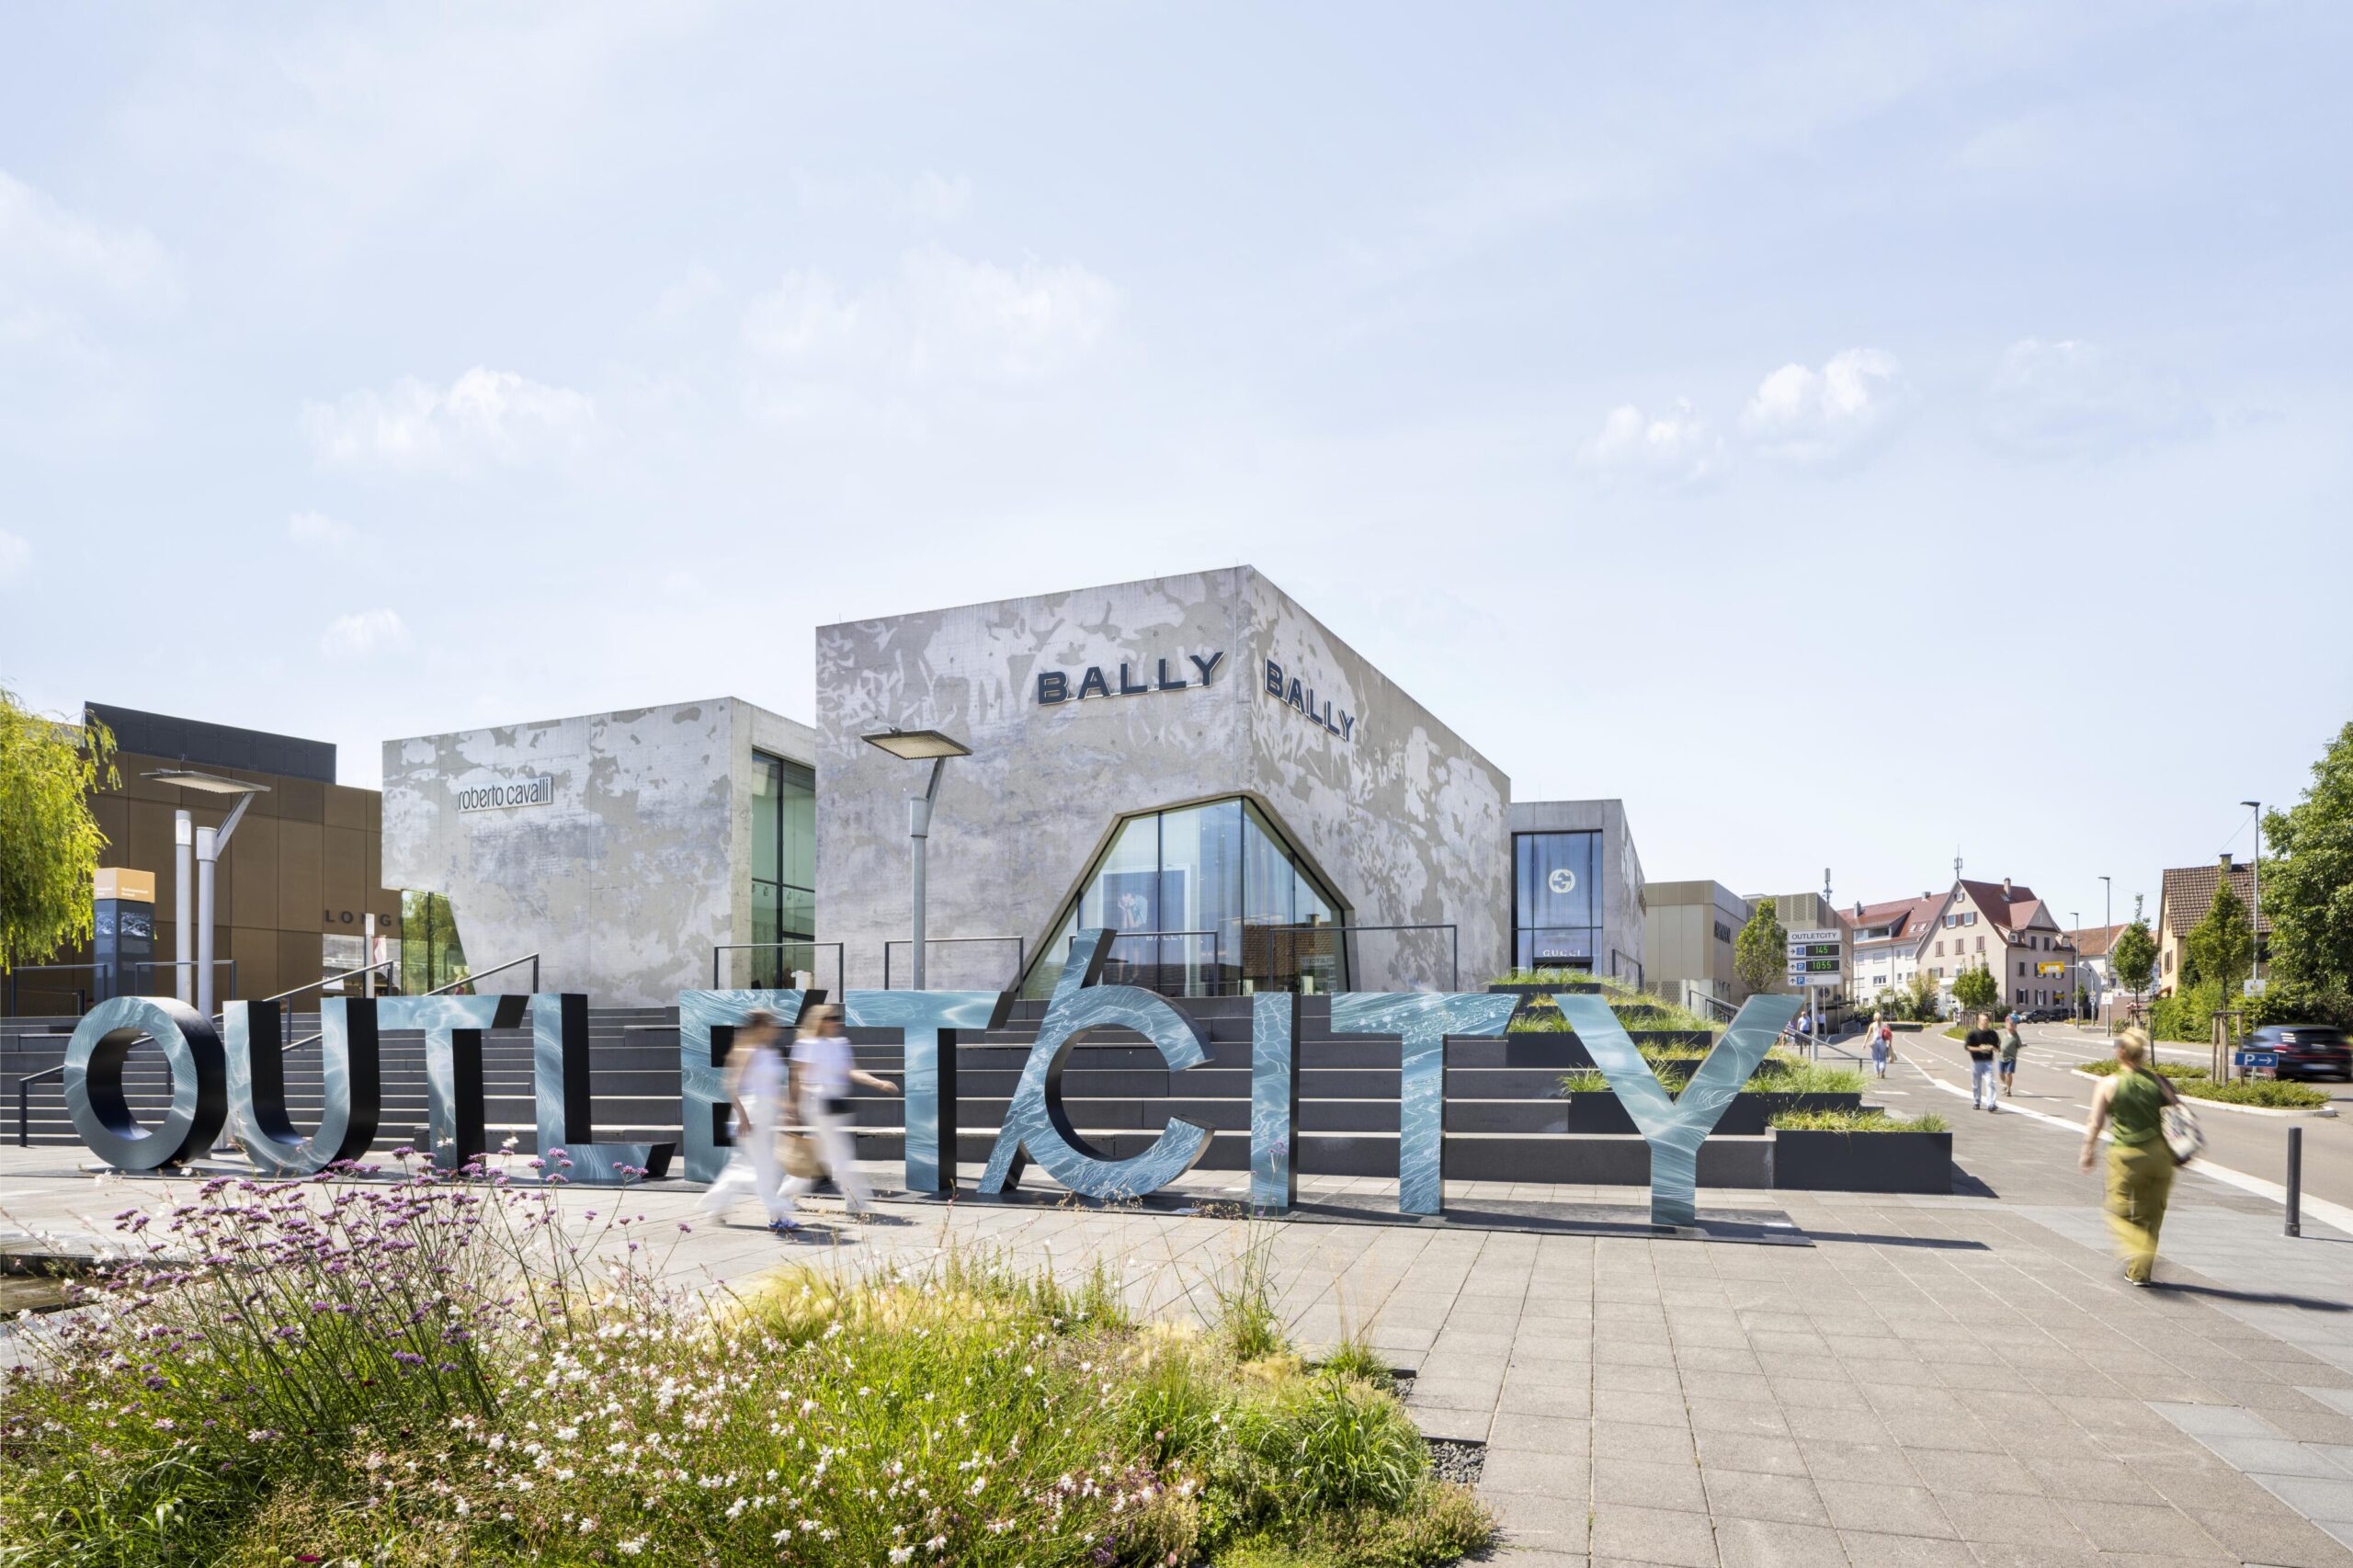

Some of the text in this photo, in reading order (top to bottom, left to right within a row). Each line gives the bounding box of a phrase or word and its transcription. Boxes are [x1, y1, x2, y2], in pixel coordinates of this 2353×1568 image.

[1038, 651, 1227, 705] BALLY
[1264, 657, 1356, 742] BALLY
[459, 778, 549, 811] roberto cavalli
[1815, 945, 1828, 954] 145
[1812, 960, 1832, 970] 1055
[2244, 1053, 2256, 1065] P
